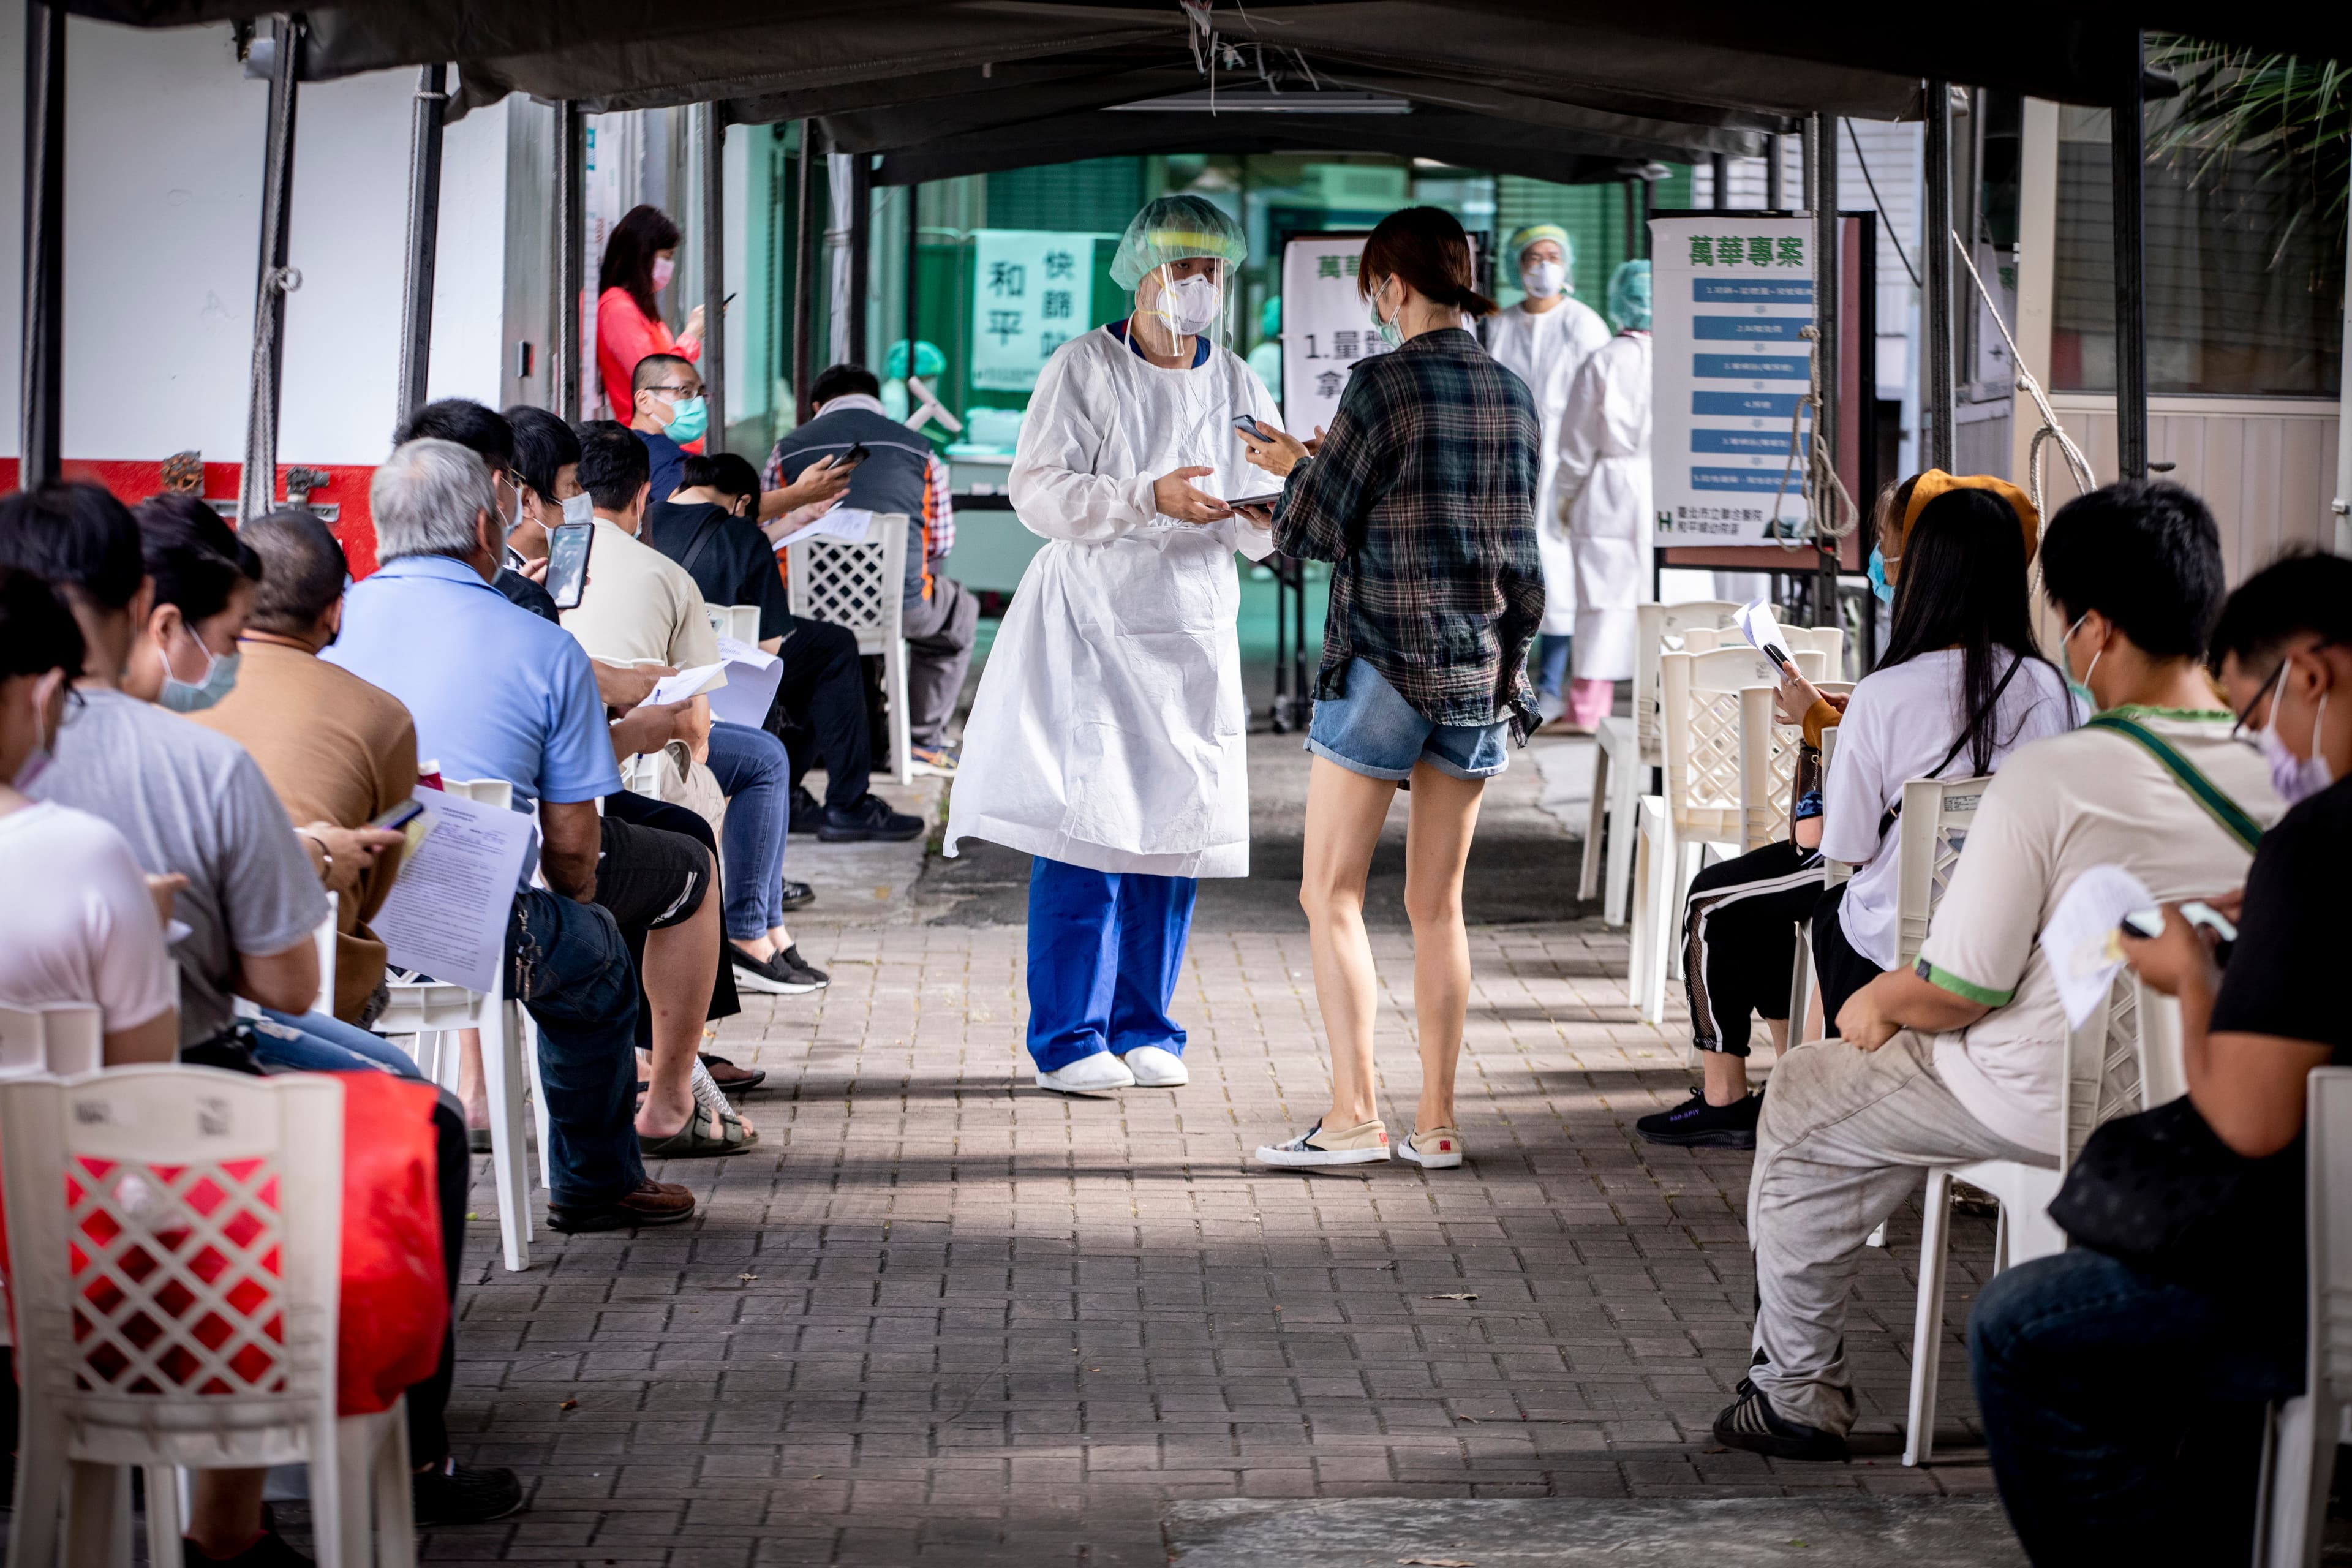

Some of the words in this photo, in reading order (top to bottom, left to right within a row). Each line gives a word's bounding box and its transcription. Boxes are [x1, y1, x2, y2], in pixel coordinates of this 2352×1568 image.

[1688, 235, 1804, 267] 萬華專案
[987, 260, 1027, 347] 和平
